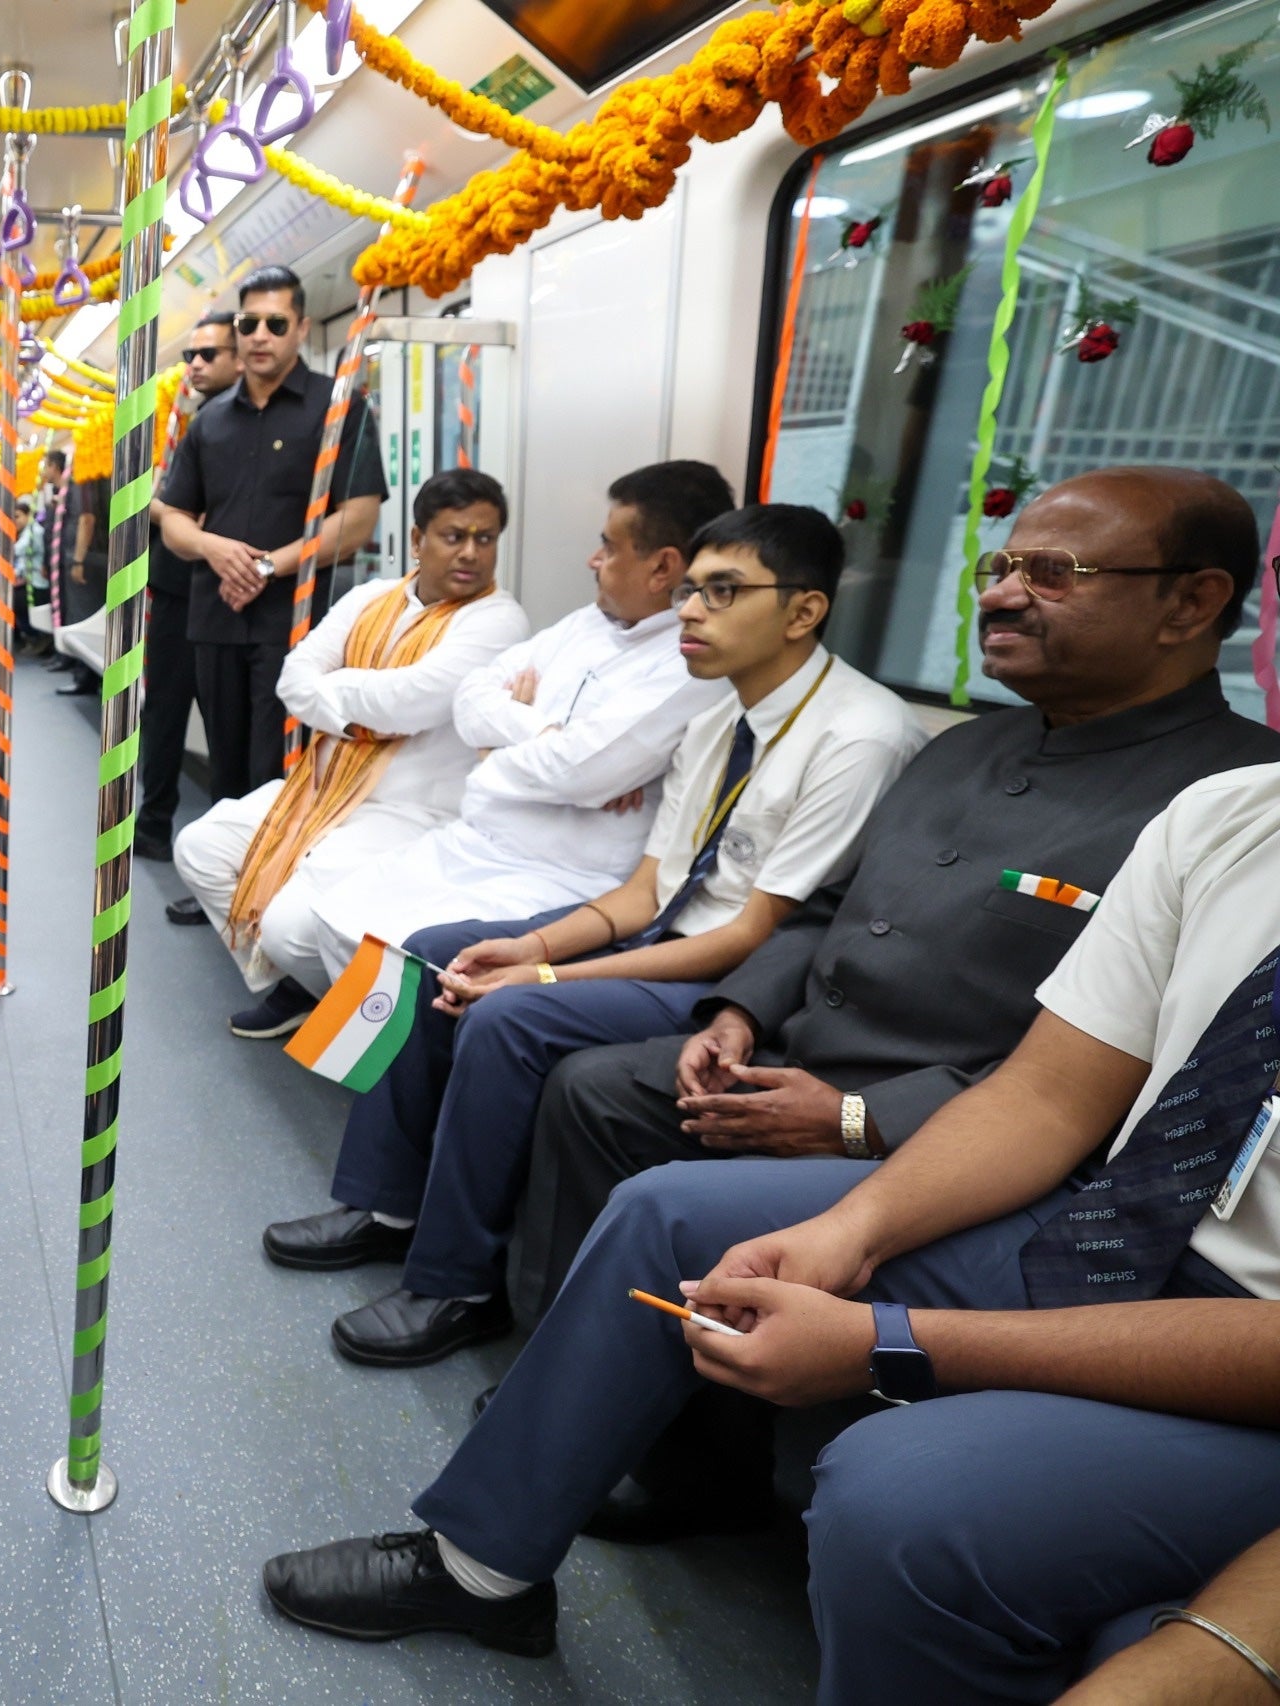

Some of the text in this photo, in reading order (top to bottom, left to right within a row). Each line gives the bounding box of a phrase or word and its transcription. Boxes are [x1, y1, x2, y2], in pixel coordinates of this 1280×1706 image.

[1159, 1088, 1200, 1111] MPBFHSS
[1165, 1119, 1207, 1141] MPBFHSS
[1173, 1150, 1217, 1172] MPBFHSS
[1069, 1208, 1116, 1221] MPBFHSS
[1076, 1239, 1125, 1251] MPBFHSS
[1087, 1270, 1136, 1283] MPBFHSS
